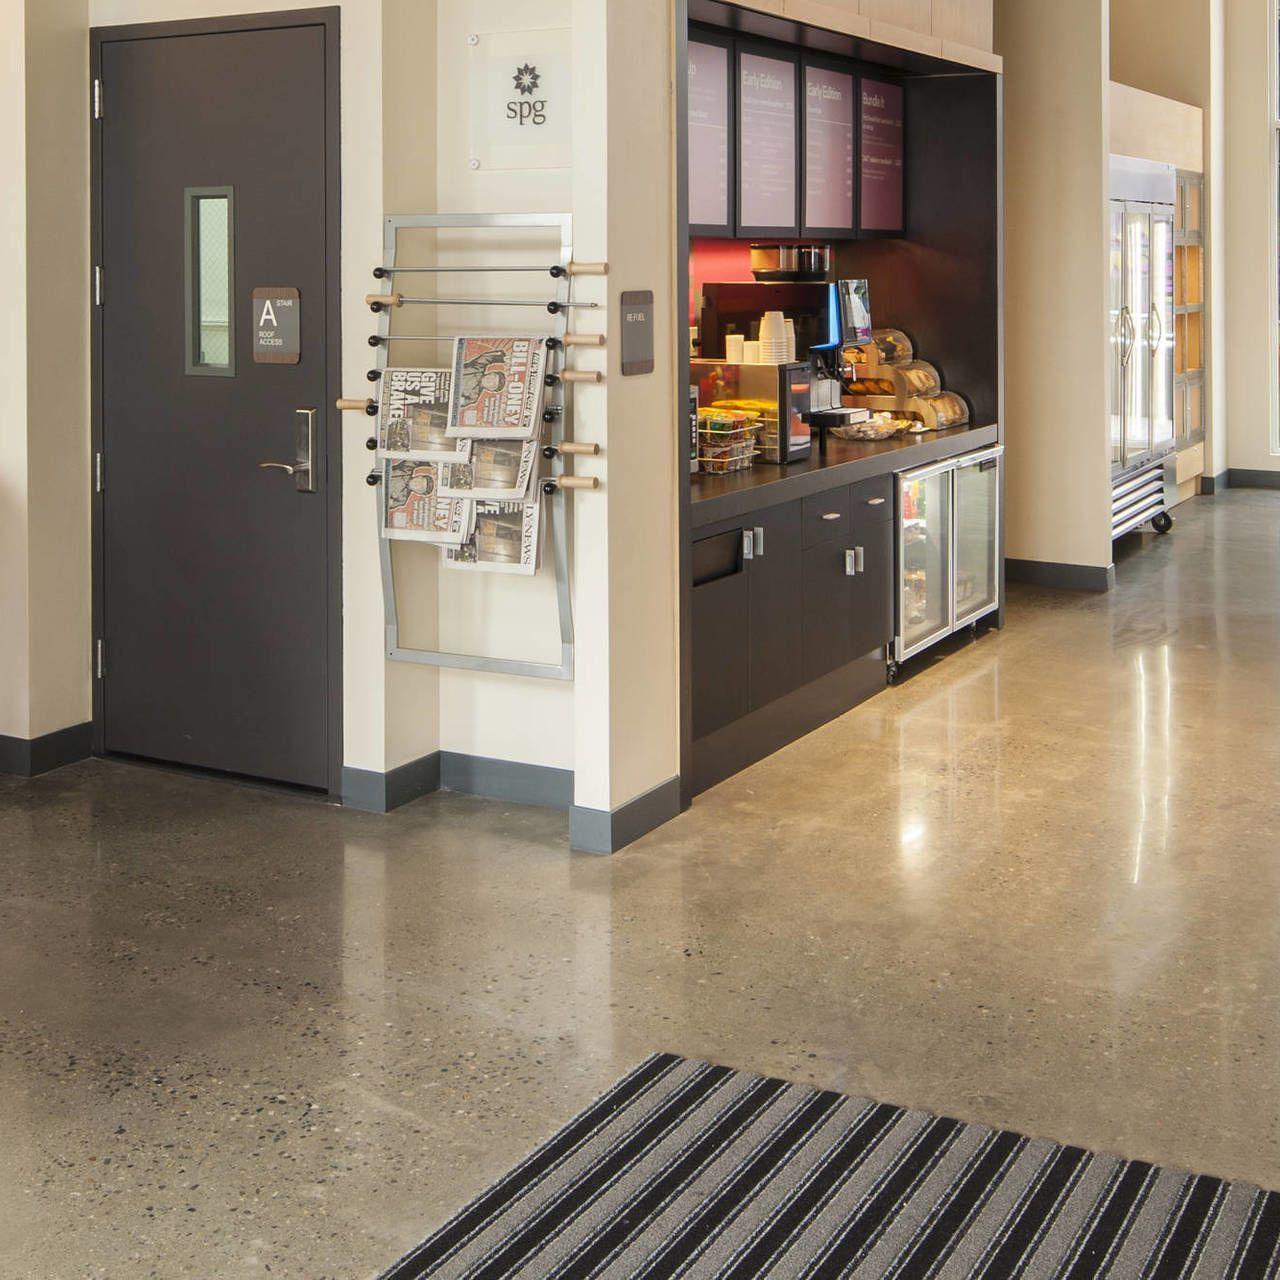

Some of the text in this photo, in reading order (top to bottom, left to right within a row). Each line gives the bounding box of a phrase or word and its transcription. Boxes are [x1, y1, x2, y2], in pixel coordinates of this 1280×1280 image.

[506, 100, 548, 126] spg
[258, 299, 278, 327] A
[258, 331, 275, 339] ROOF
[259, 338, 282, 346] ACCESS
[419, 372, 436, 405] GIVE
